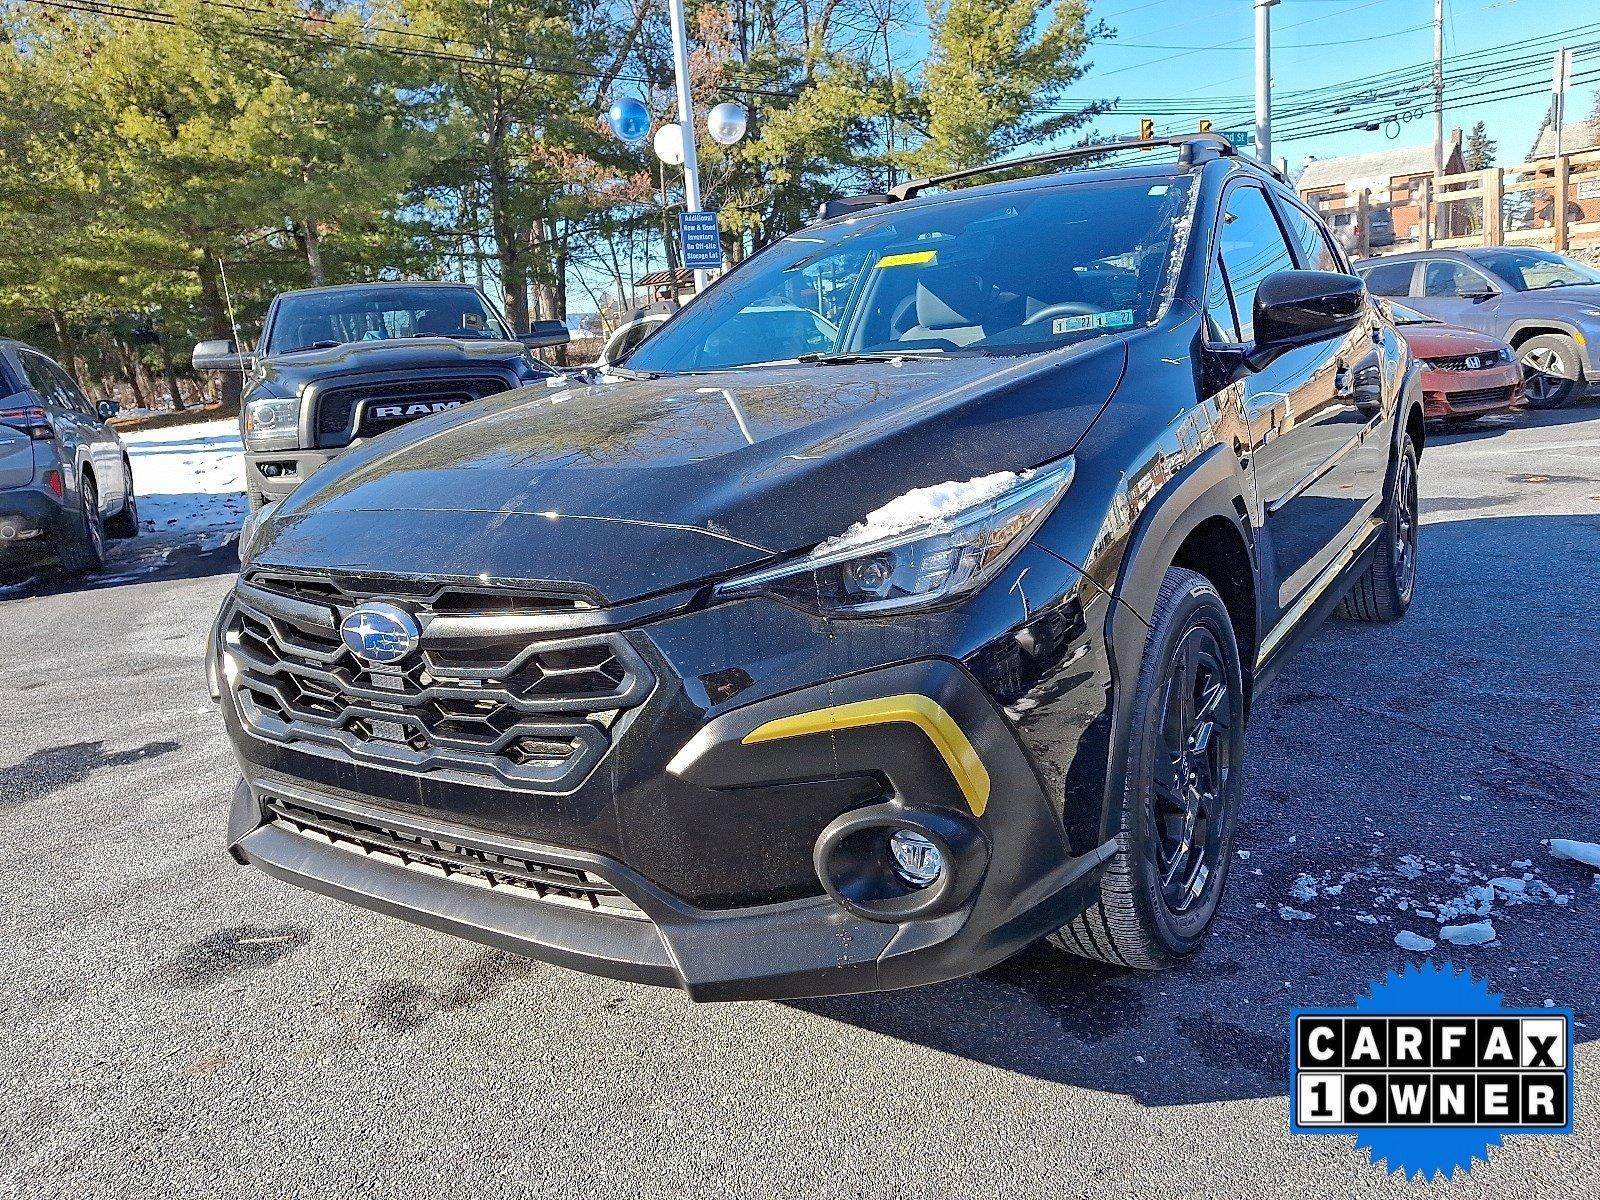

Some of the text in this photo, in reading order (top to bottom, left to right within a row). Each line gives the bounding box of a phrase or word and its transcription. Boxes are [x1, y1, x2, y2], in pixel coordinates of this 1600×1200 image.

[1237, 133, 1244, 142] St
[709, 251, 719, 259] Lot
[1081, 316, 1090, 327] 27
[376, 401, 460, 417] RAM
